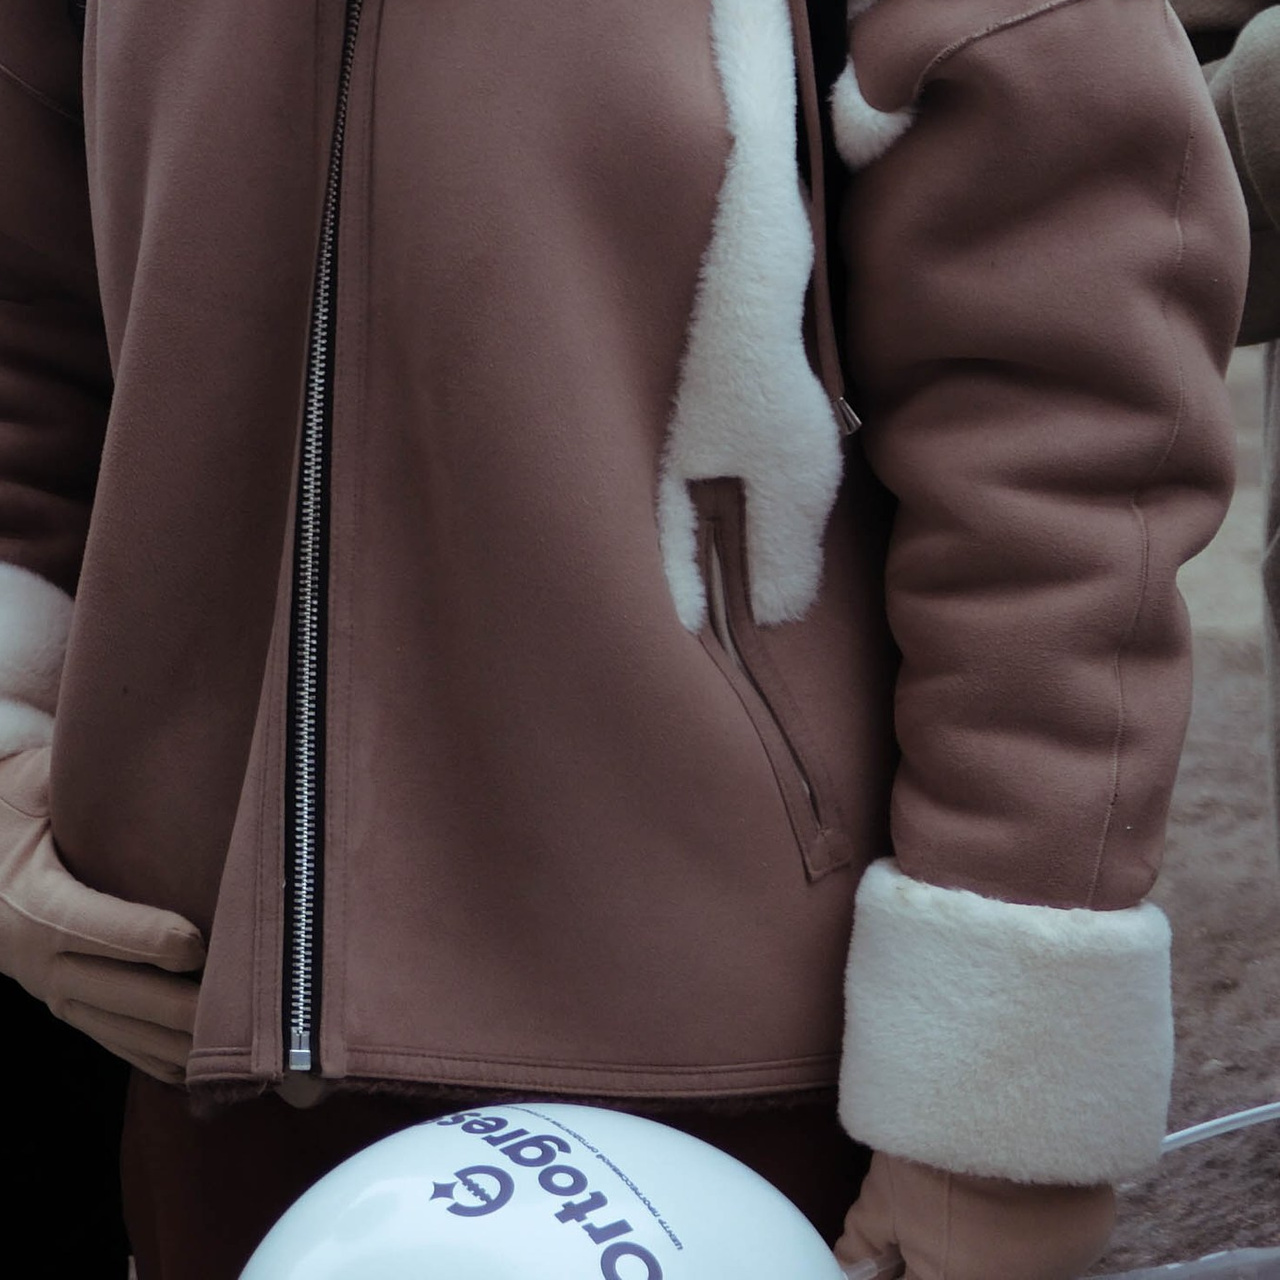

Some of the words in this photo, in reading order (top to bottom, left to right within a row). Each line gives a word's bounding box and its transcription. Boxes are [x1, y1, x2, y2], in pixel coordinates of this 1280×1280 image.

[422, 1111, 663, 1280] Ortogres
[595, 1153, 661, 1218] ПРОГРЕССИВНОЙ
[657, 1218, 684, 1251] ЦЕНТР
